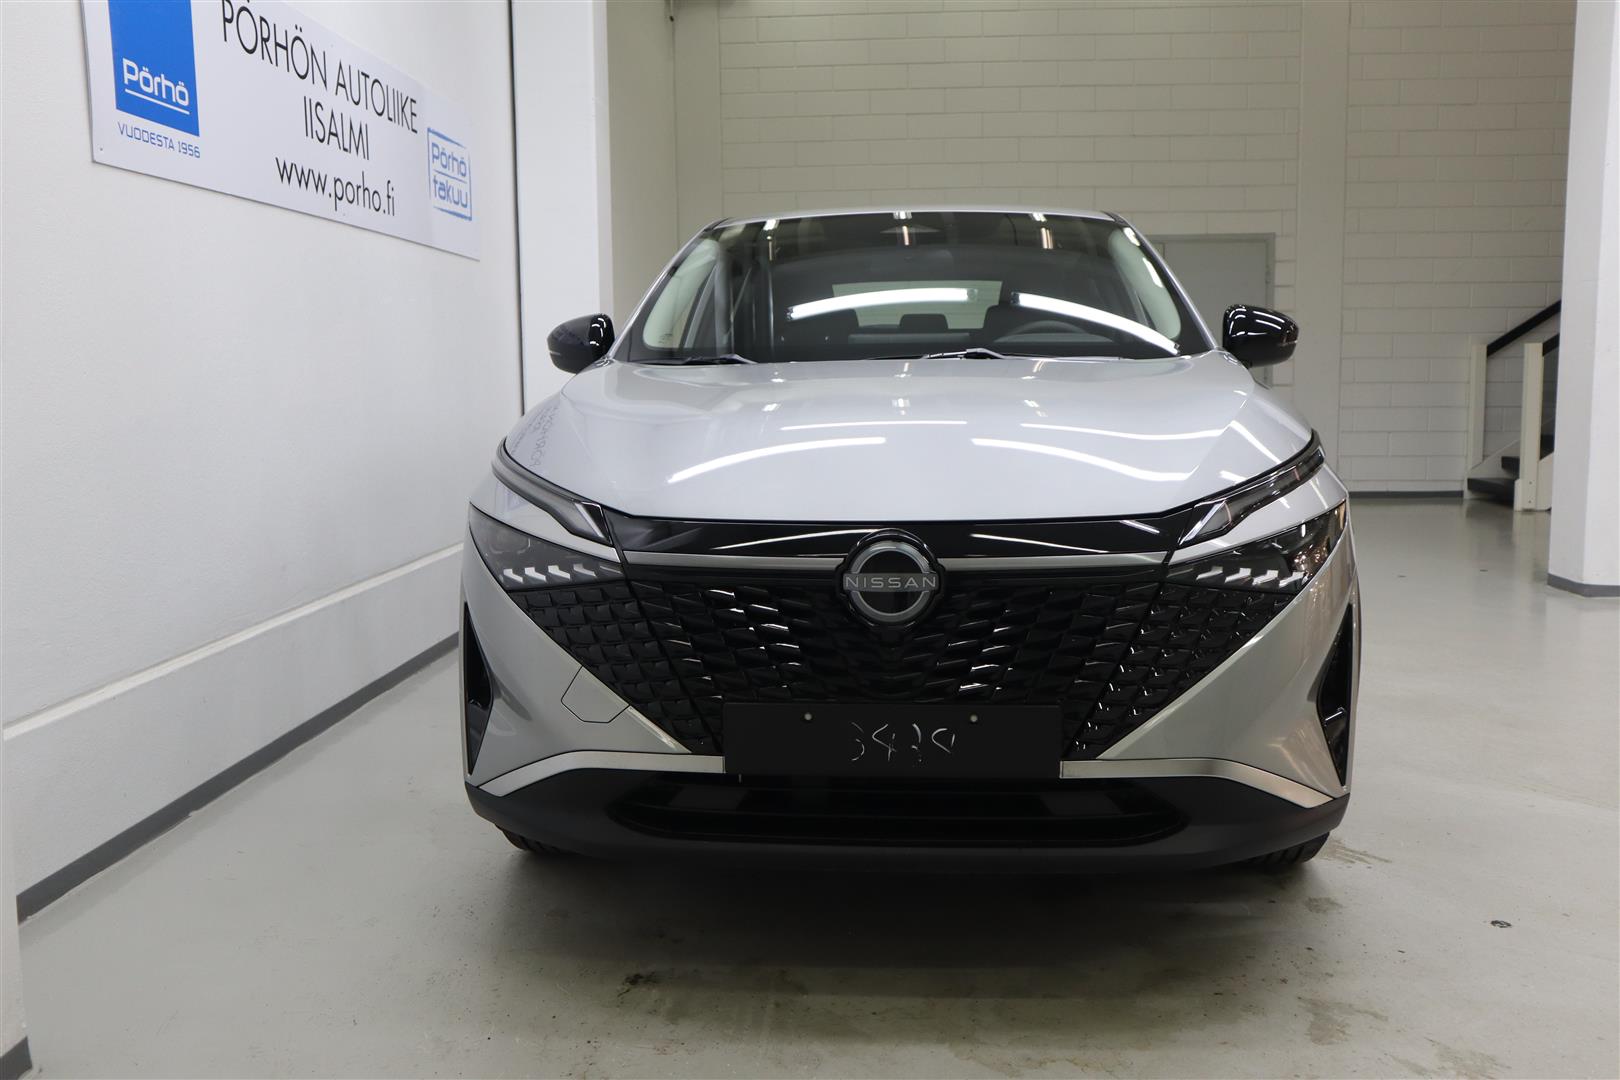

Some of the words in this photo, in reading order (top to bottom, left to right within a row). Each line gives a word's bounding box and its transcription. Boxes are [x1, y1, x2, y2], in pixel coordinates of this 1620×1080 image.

[122, 57, 189, 107] Pörhö
[221, 0, 327, 91] PÖRHÖN
[335, 58, 418, 134] AUTOLIIKE
[117, 121, 175, 152] VUODESTA
[178, 140, 201, 159] 1956
[303, 95, 370, 161] IISALMI
[431, 142, 467, 178] Pörhö
[275, 156, 395, 217] www.porho.fi
[432, 174, 468, 209] takuu
[845, 576, 936, 588] NISSAN
